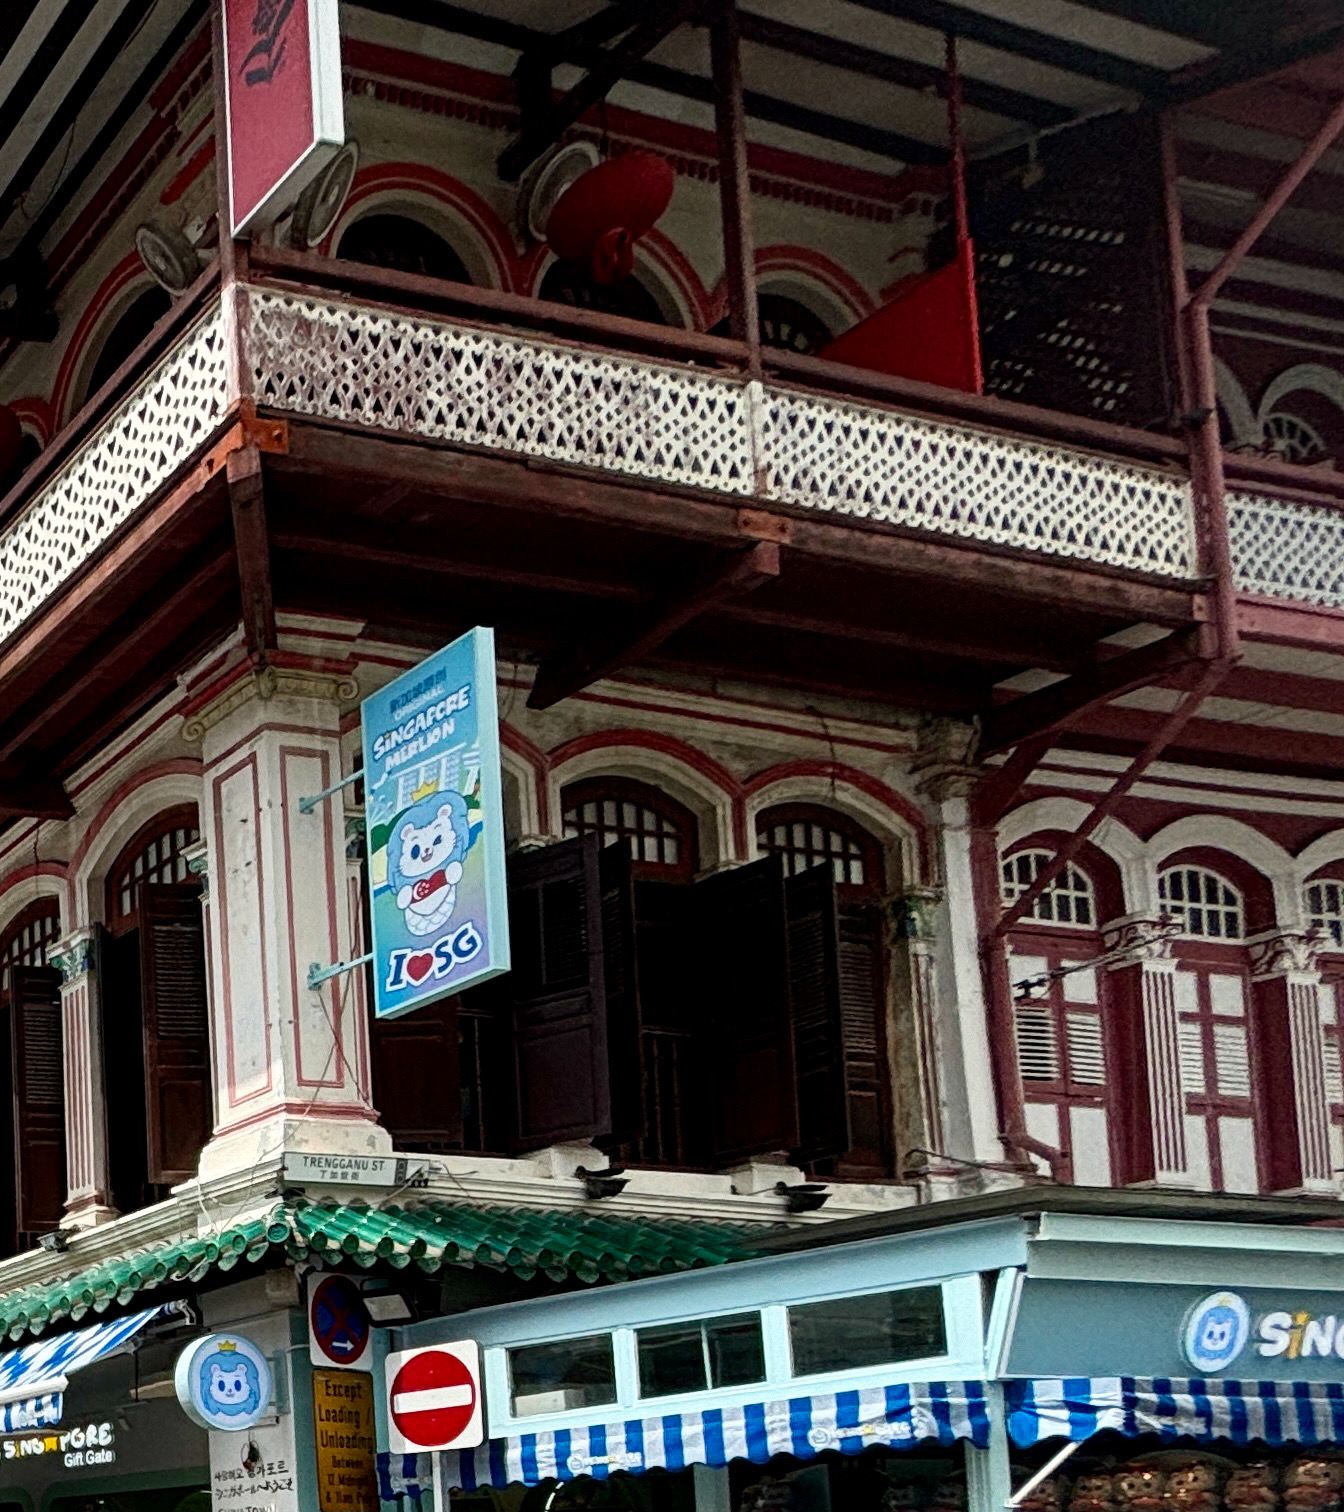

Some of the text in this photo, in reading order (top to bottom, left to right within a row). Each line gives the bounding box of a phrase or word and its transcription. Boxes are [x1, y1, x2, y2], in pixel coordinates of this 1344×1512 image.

[385, 718, 454, 772] MERLION
[435, 927, 477, 974] SG
[302, 1156, 385, 1171] TRENGGANU ST
[325, 1380, 362, 1402] Except
[318, 1403, 361, 1429] Loading
[320, 1430, 374, 1454] Unloading
[64, 1448, 113, 1468] Gift Gate
